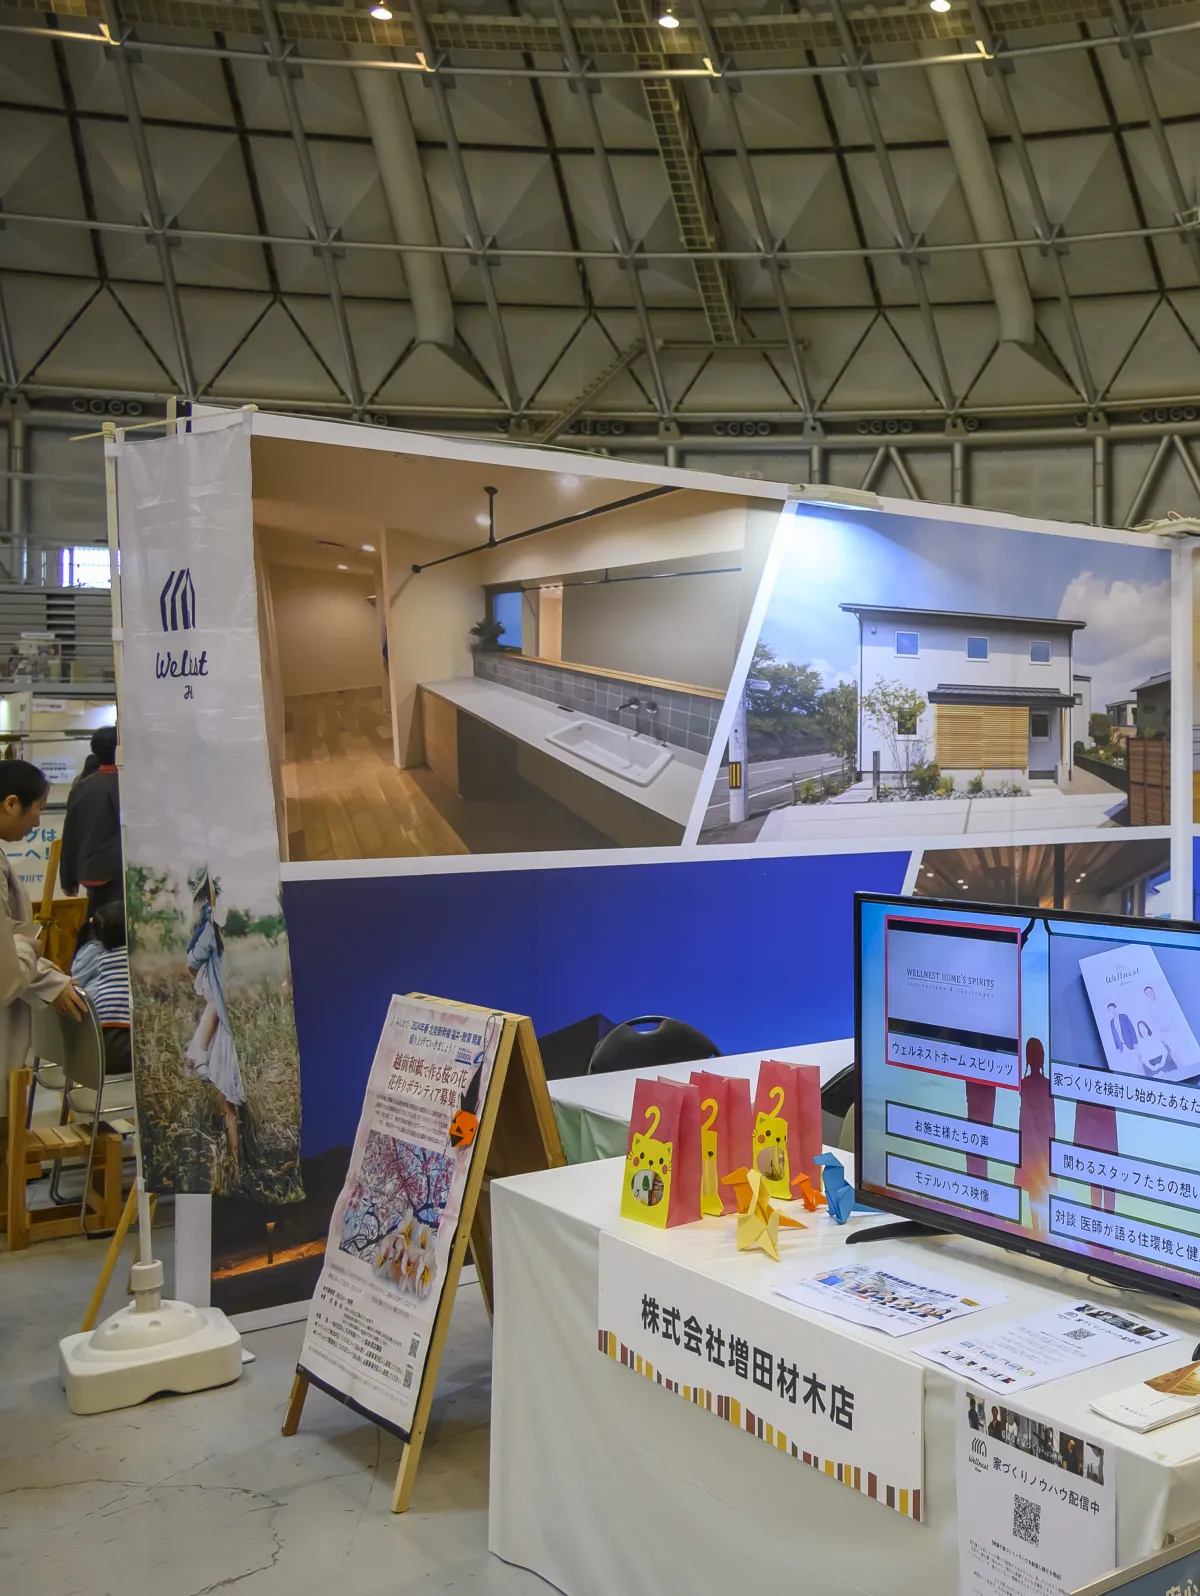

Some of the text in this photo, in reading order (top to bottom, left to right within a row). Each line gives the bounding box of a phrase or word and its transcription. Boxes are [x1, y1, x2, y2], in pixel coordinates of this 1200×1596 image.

[906, 968, 995, 988] WELLNEST HOME'S SPIRITS
[1105, 967, 1140, 984] Wellnest
[392, 1051, 469, 1089] 越前和紙で作る桜の花
[892, 1041, 1013, 1076] ウェルネストホーム スピリッツ
[914, 1119, 990, 1149] お施主様たちの声
[915, 1170, 990, 1204] モデルハウス映像
[1055, 1209, 1076, 1227] 対談
[641, 1293, 855, 1432] 株式会社増田材木店
[992, 1456, 1100, 1515] 家づくりノウハウ配信中
